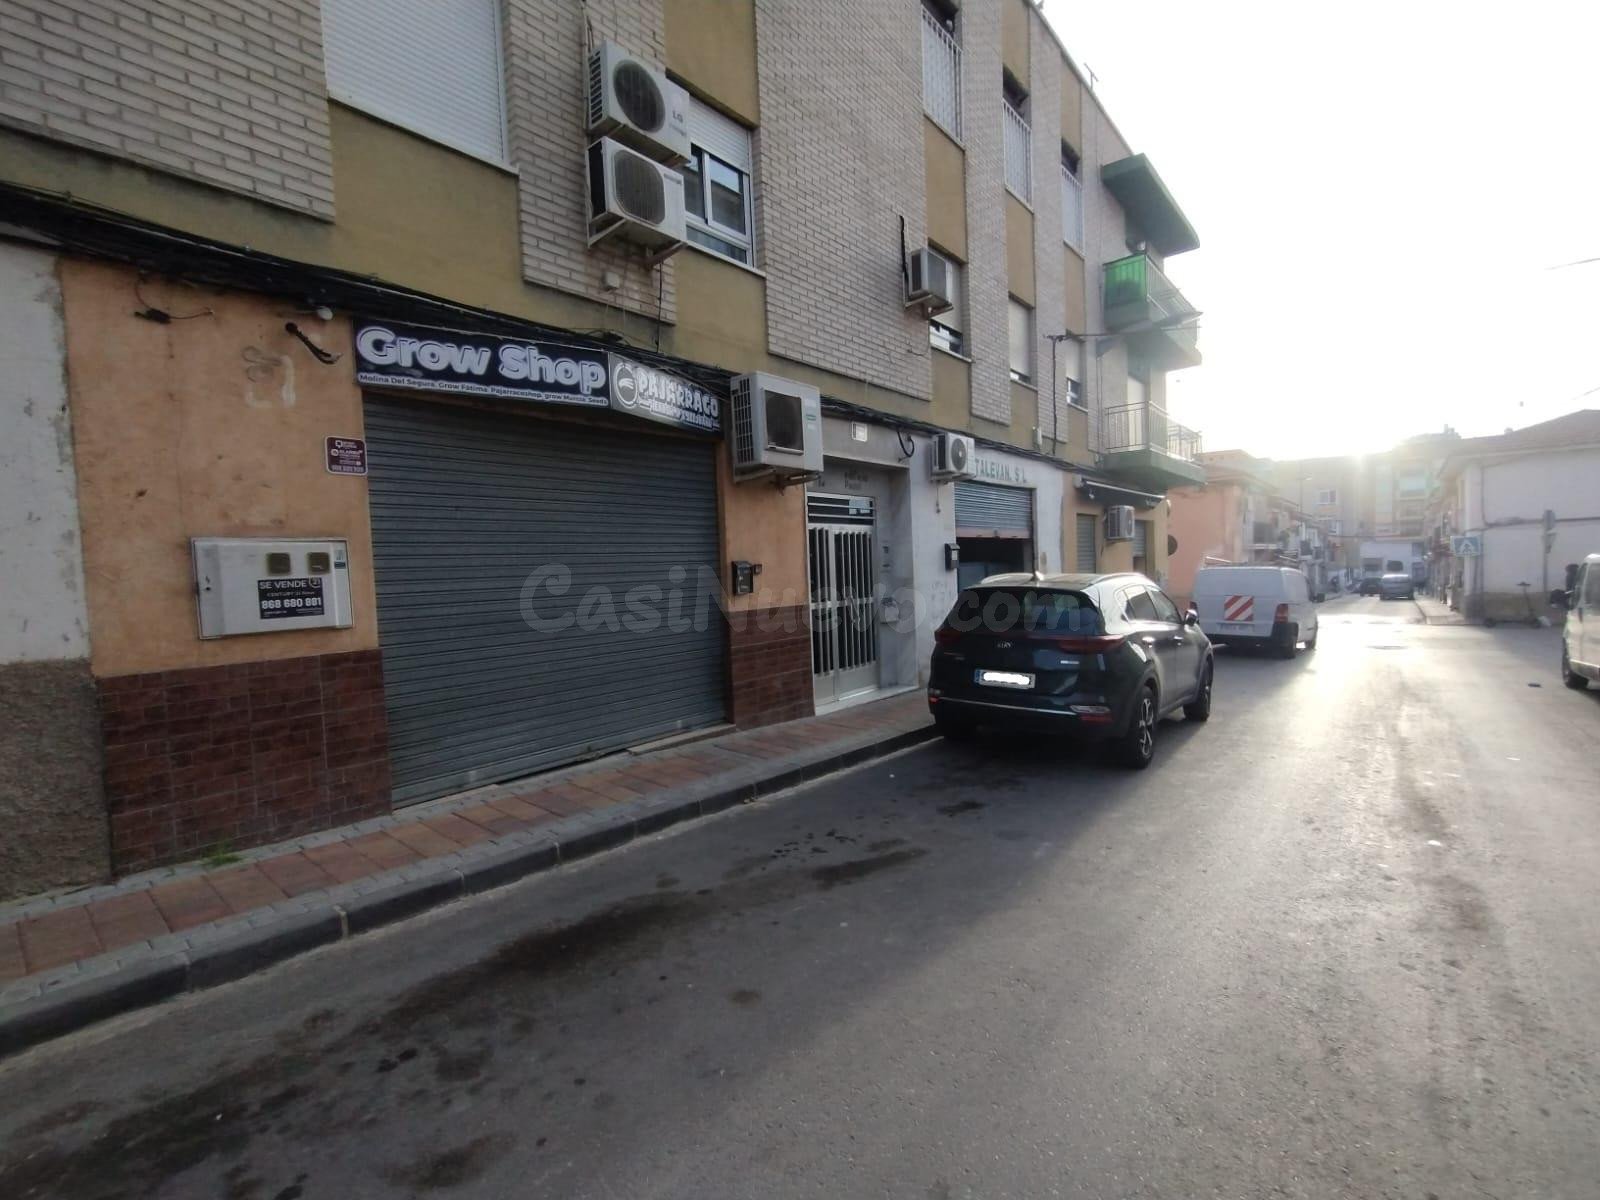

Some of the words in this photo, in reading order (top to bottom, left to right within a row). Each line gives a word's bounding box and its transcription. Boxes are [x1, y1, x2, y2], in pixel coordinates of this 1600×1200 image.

[356, 326, 490, 375] Grow
[498, 344, 607, 394] Shop
[359, 373, 389, 384] Molina
[391, 377, 405, 385] Del
[439, 382, 460, 390] Grow
[259, 581, 273, 590] SE
[274, 579, 307, 589] VENDE
[261, 599, 282, 609] 868
[283, 598, 303, 608] 680
[304, 597, 322, 607] 881
